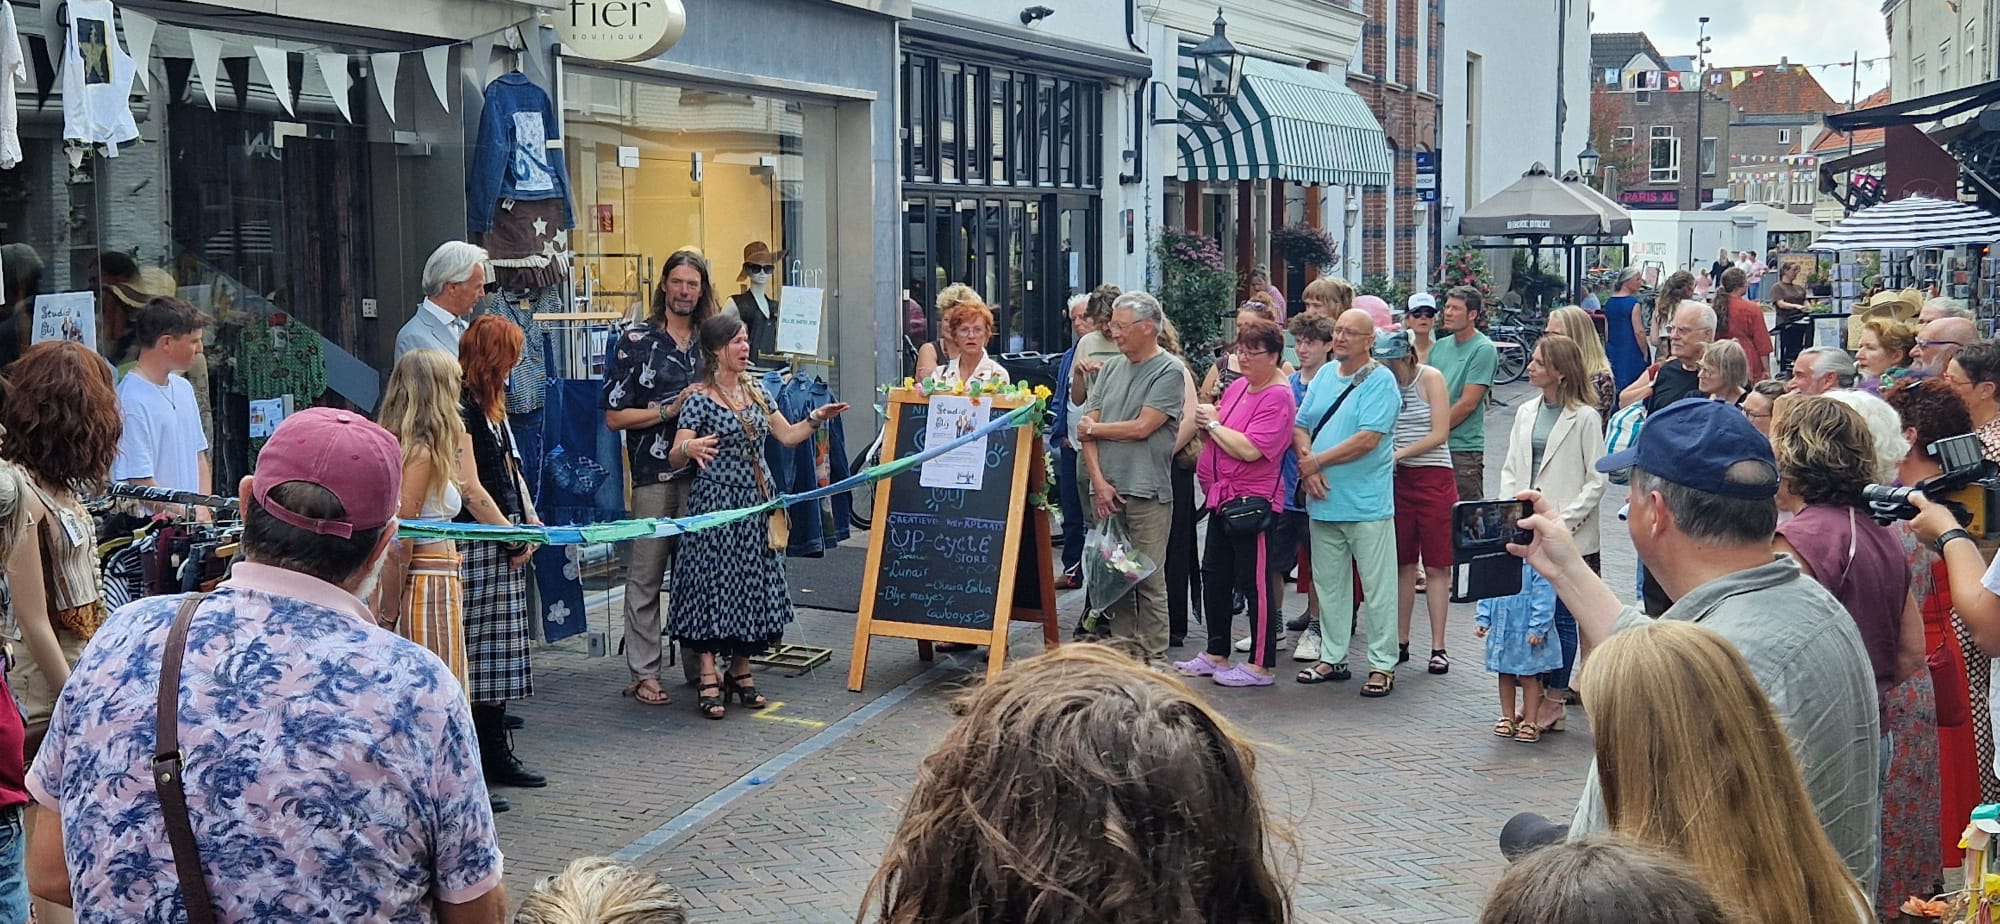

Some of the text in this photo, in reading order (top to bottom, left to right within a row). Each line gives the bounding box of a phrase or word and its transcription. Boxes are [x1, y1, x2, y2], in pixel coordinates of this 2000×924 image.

[569, 0, 651, 27] fier
[1625, 192, 1657, 202] PARIS
[1662, 192, 1676, 202] XL
[792, 260, 822, 287] fier
[41, 304, 71, 319] Studio
[936, 402, 967, 415] Studio
[955, 553, 988, 563] STORE
[927, 608, 974, 624] Cowboys
